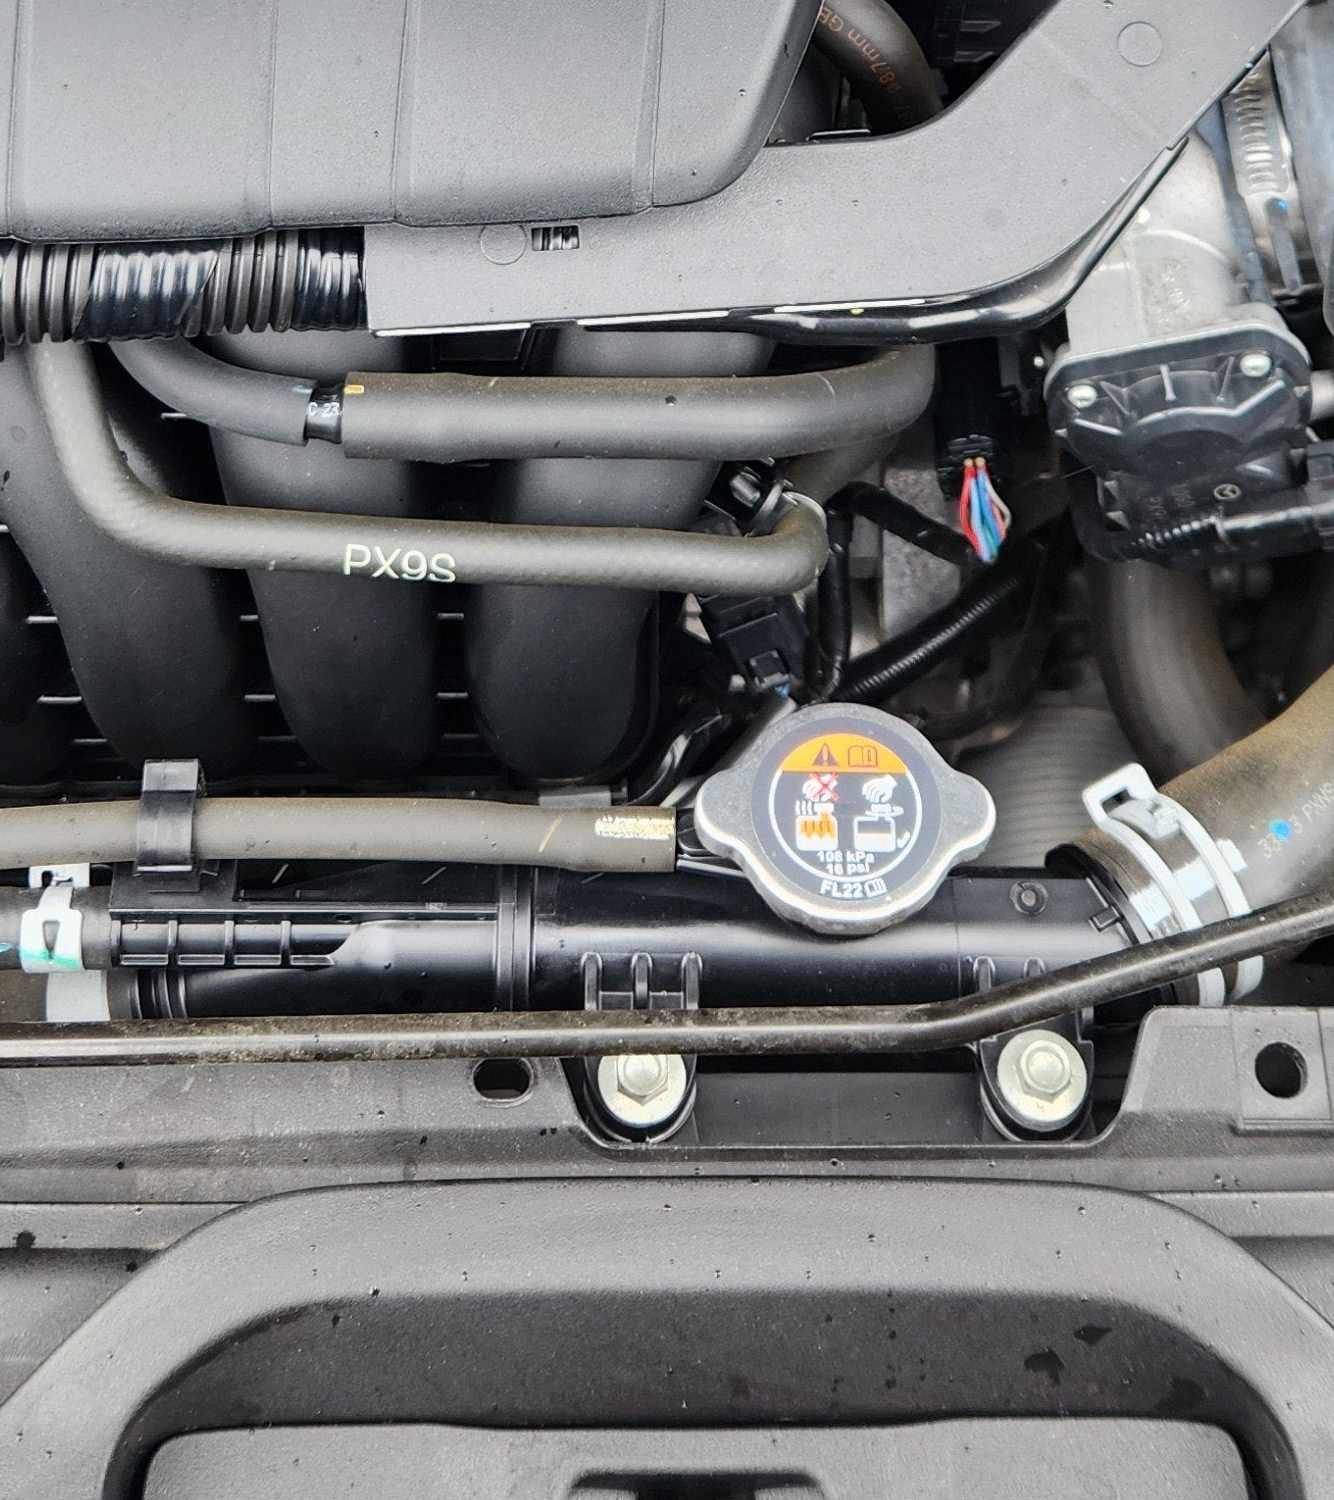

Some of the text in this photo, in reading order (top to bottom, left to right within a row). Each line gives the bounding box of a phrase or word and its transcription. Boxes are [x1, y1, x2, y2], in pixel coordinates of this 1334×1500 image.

[342, 543, 457, 583] PX9S
[846, 850, 875, 864] kPa
[819, 878, 865, 898] FL22
